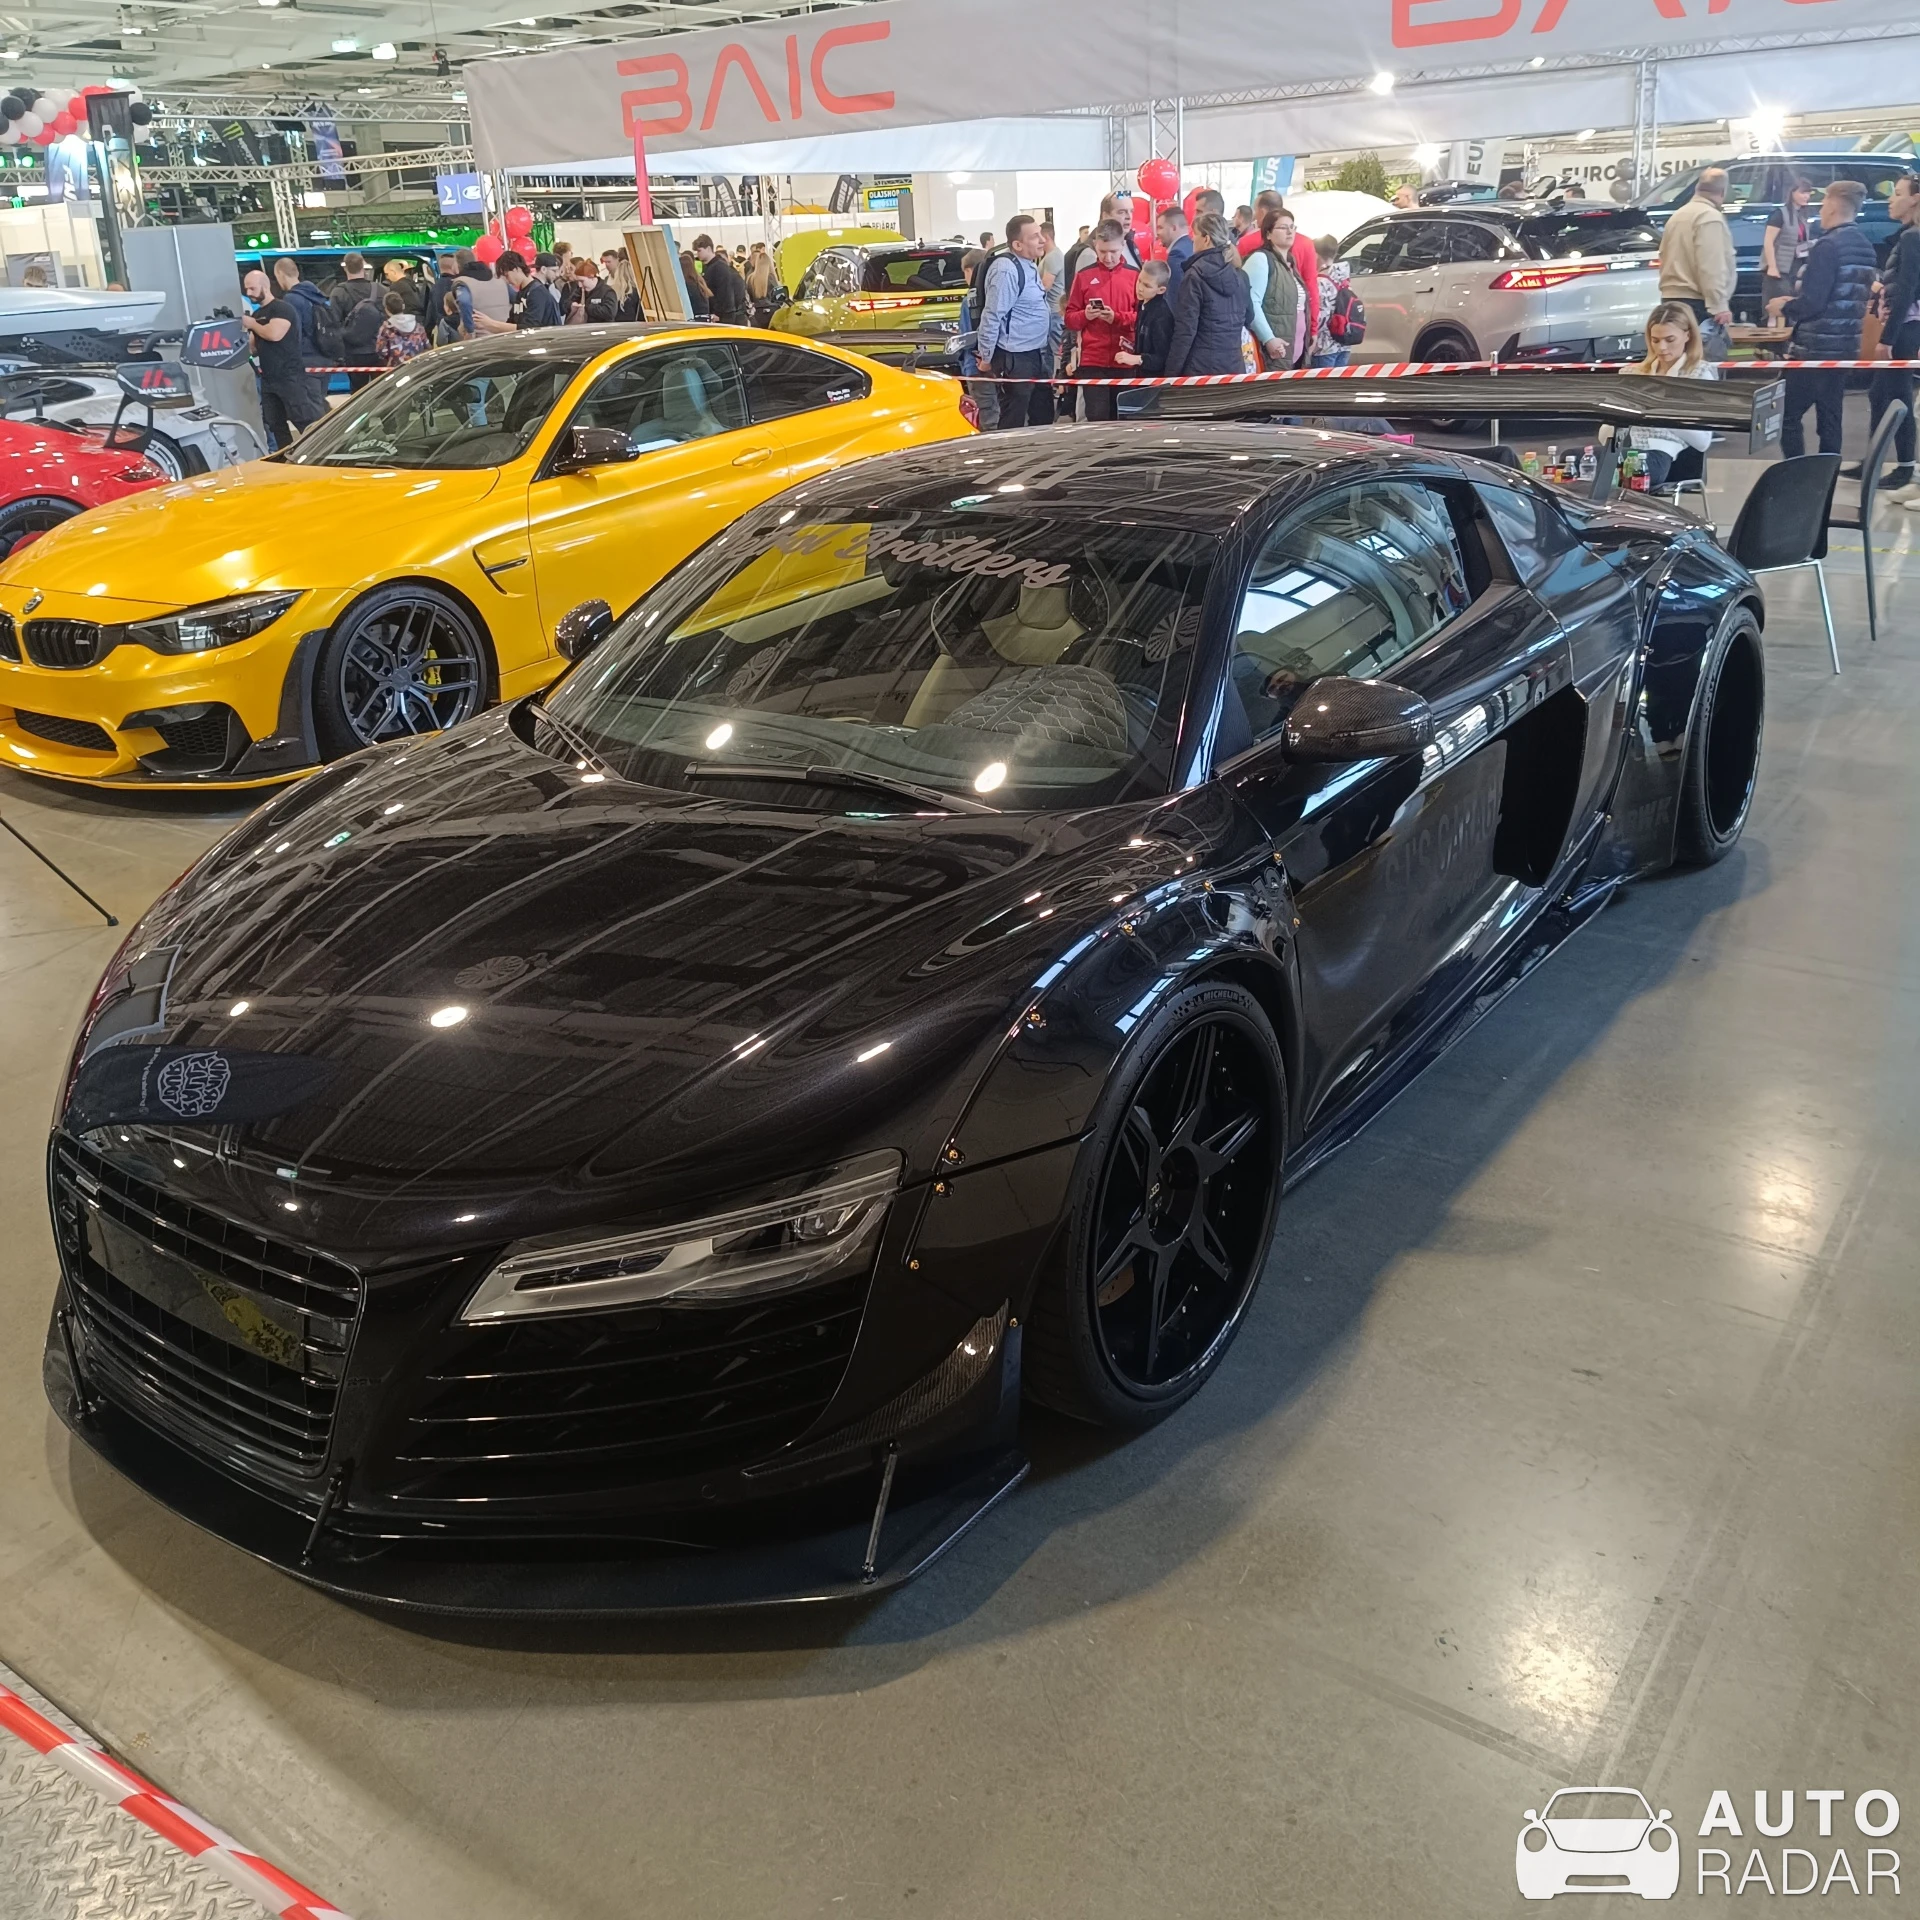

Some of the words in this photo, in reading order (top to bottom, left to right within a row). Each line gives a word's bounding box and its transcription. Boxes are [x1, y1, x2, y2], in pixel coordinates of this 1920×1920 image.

[616, 20, 896, 138] BAIC
[1617, 338, 1632, 350] X7
[200, 349, 234, 358] MANTHEY
[139, 387, 178, 395] MANTHEY
[834, 528, 1071, 589] Brothers
[1203, 990, 1240, 1001] MICHELIN
